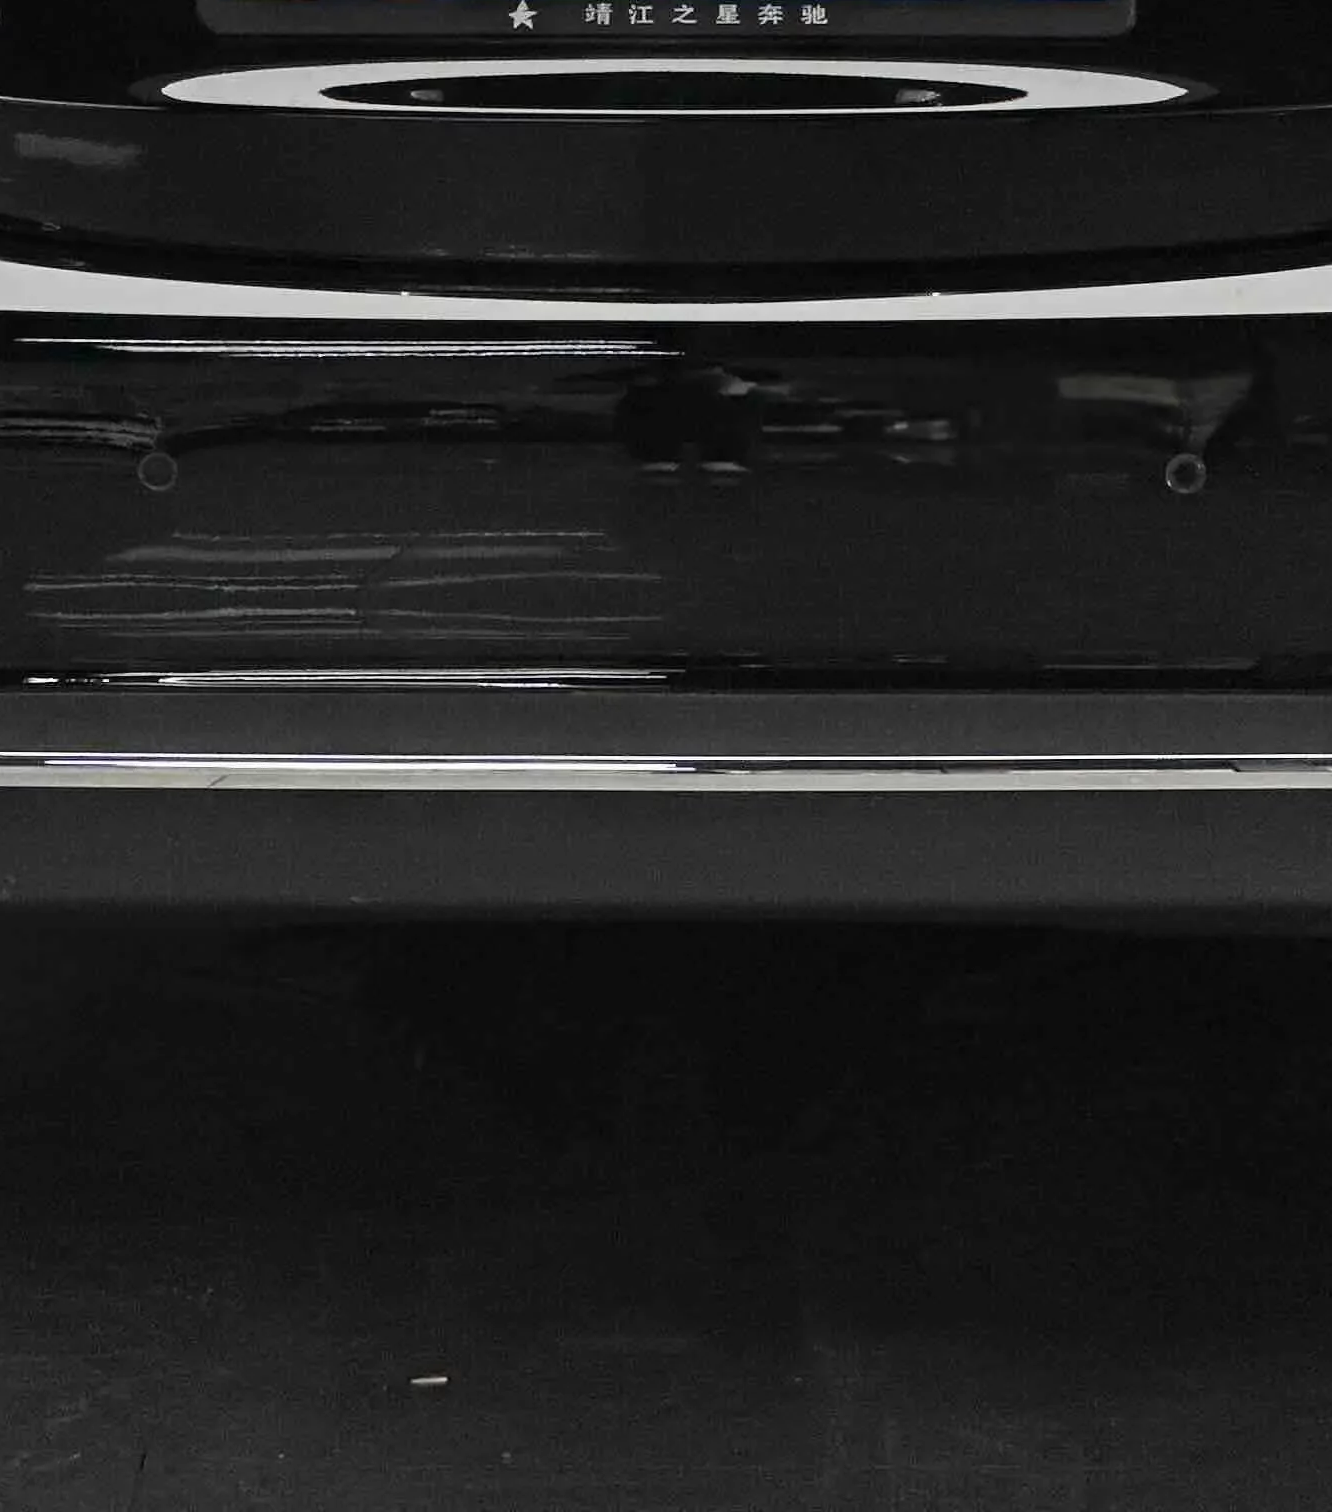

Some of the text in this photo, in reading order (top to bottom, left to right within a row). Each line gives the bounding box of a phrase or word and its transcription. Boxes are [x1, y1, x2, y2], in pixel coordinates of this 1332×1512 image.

[585, 2, 829, 26] 靖江之星奔驰
